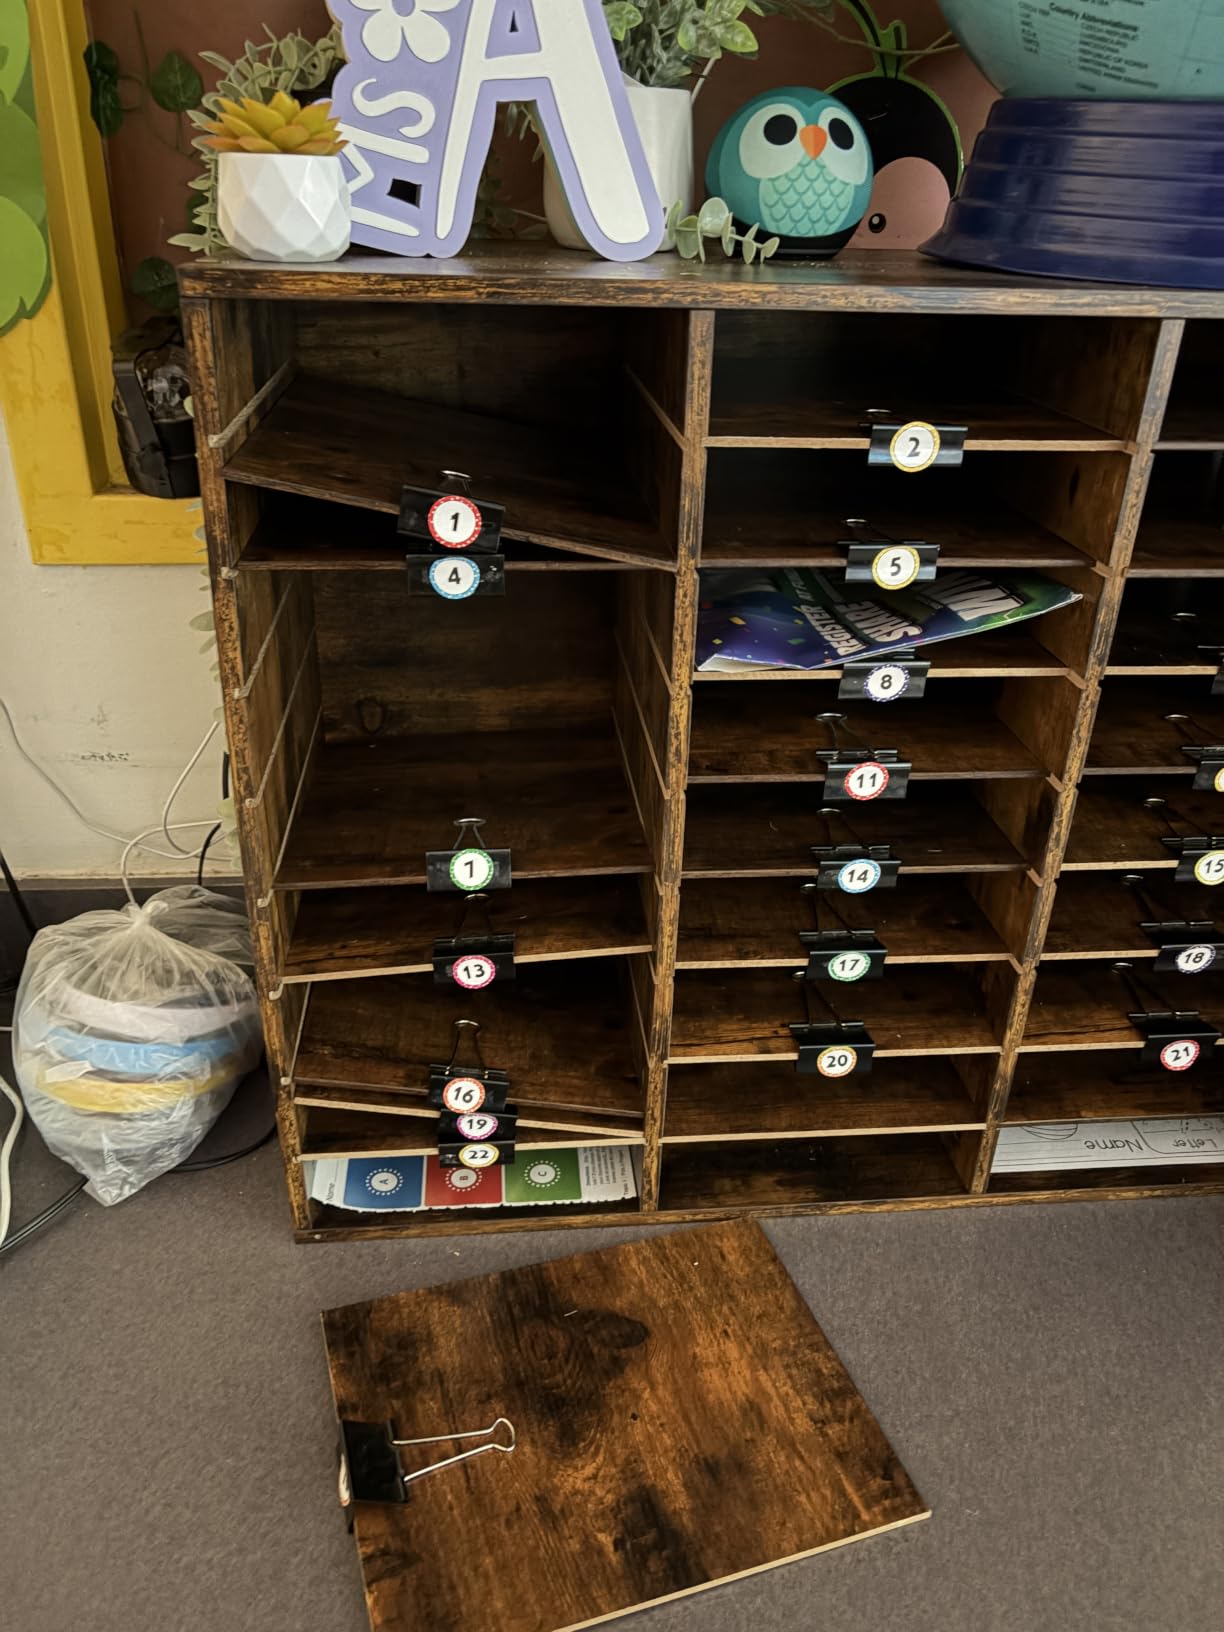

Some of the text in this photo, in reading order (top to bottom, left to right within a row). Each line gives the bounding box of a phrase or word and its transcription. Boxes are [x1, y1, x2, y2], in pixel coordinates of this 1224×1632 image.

[907, 437, 921, 458] 2
[449, 512, 460, 531] 1
[889, 556, 901, 577] 5
[448, 567, 461, 585] 4
[835, 600, 923, 642] SHARE
[800, 604, 868, 656] REGISTER
[880, 674, 892, 690] 8
[856, 772, 877, 788] 11
[1203, 858, 1224, 874] 15
[847, 869, 868, 883] 14
[838, 958, 860, 972] 17
[1183, 951, 1204, 964] 18
[463, 964, 485, 979] 13
[826, 1054, 848, 1068] 20
[1171, 1046, 1190, 1062] 21
[453, 1087, 475, 1103] 16
[467, 1119, 487, 1130] 19
[1084, 1137, 1144, 1153] Name
[1171, 1138, 1218, 1149] Letter
[468, 1150, 489, 1160] 22
